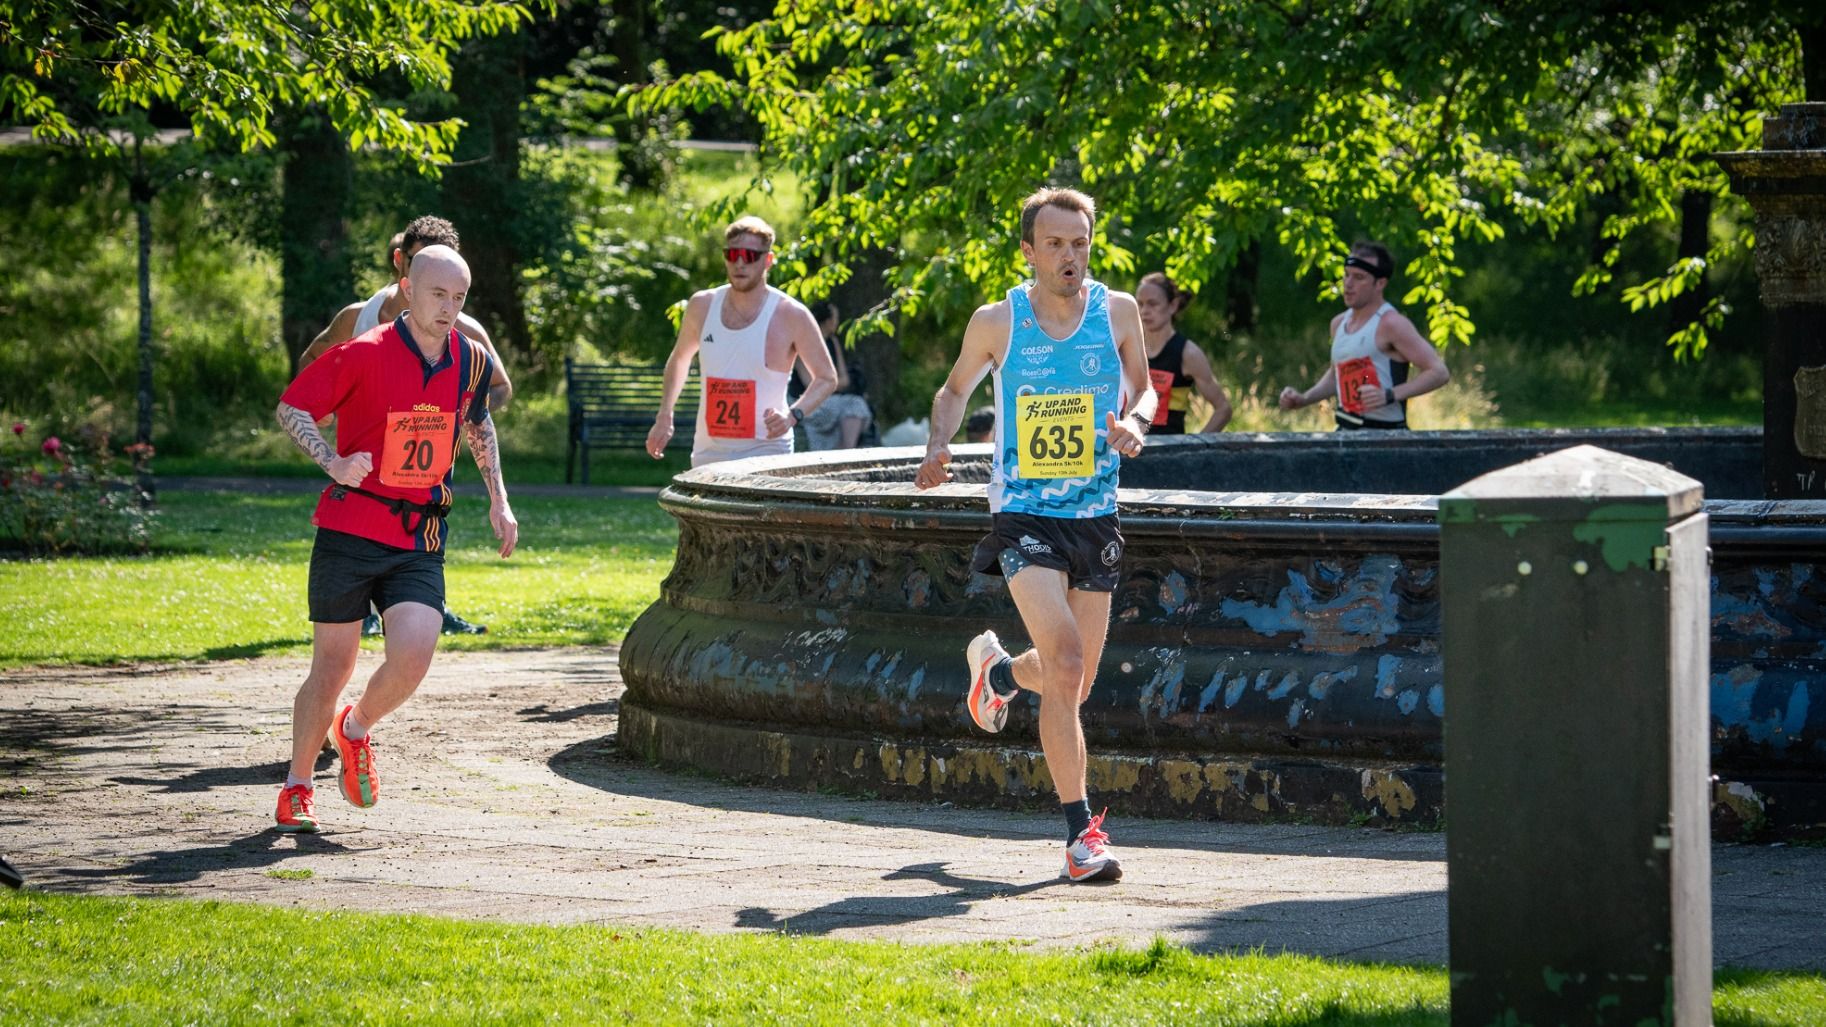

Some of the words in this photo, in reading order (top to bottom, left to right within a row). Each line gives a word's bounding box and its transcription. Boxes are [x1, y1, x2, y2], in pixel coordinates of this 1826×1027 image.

[1021, 345, 1054, 355] COLSON
[1344, 376, 1368, 405] 13
[413, 403, 440, 412] adidas
[1045, 399, 1060, 409] UP
[1060, 397, 1082, 406] AND
[716, 400, 741, 426] 24
[1040, 405, 1087, 418] RUNNING
[412, 416, 424, 424] UP
[424, 415, 445, 424] AND
[408, 423, 448, 432] RUNNING
[1029, 424, 1085, 460] 635
[400, 439, 433, 471] 20
